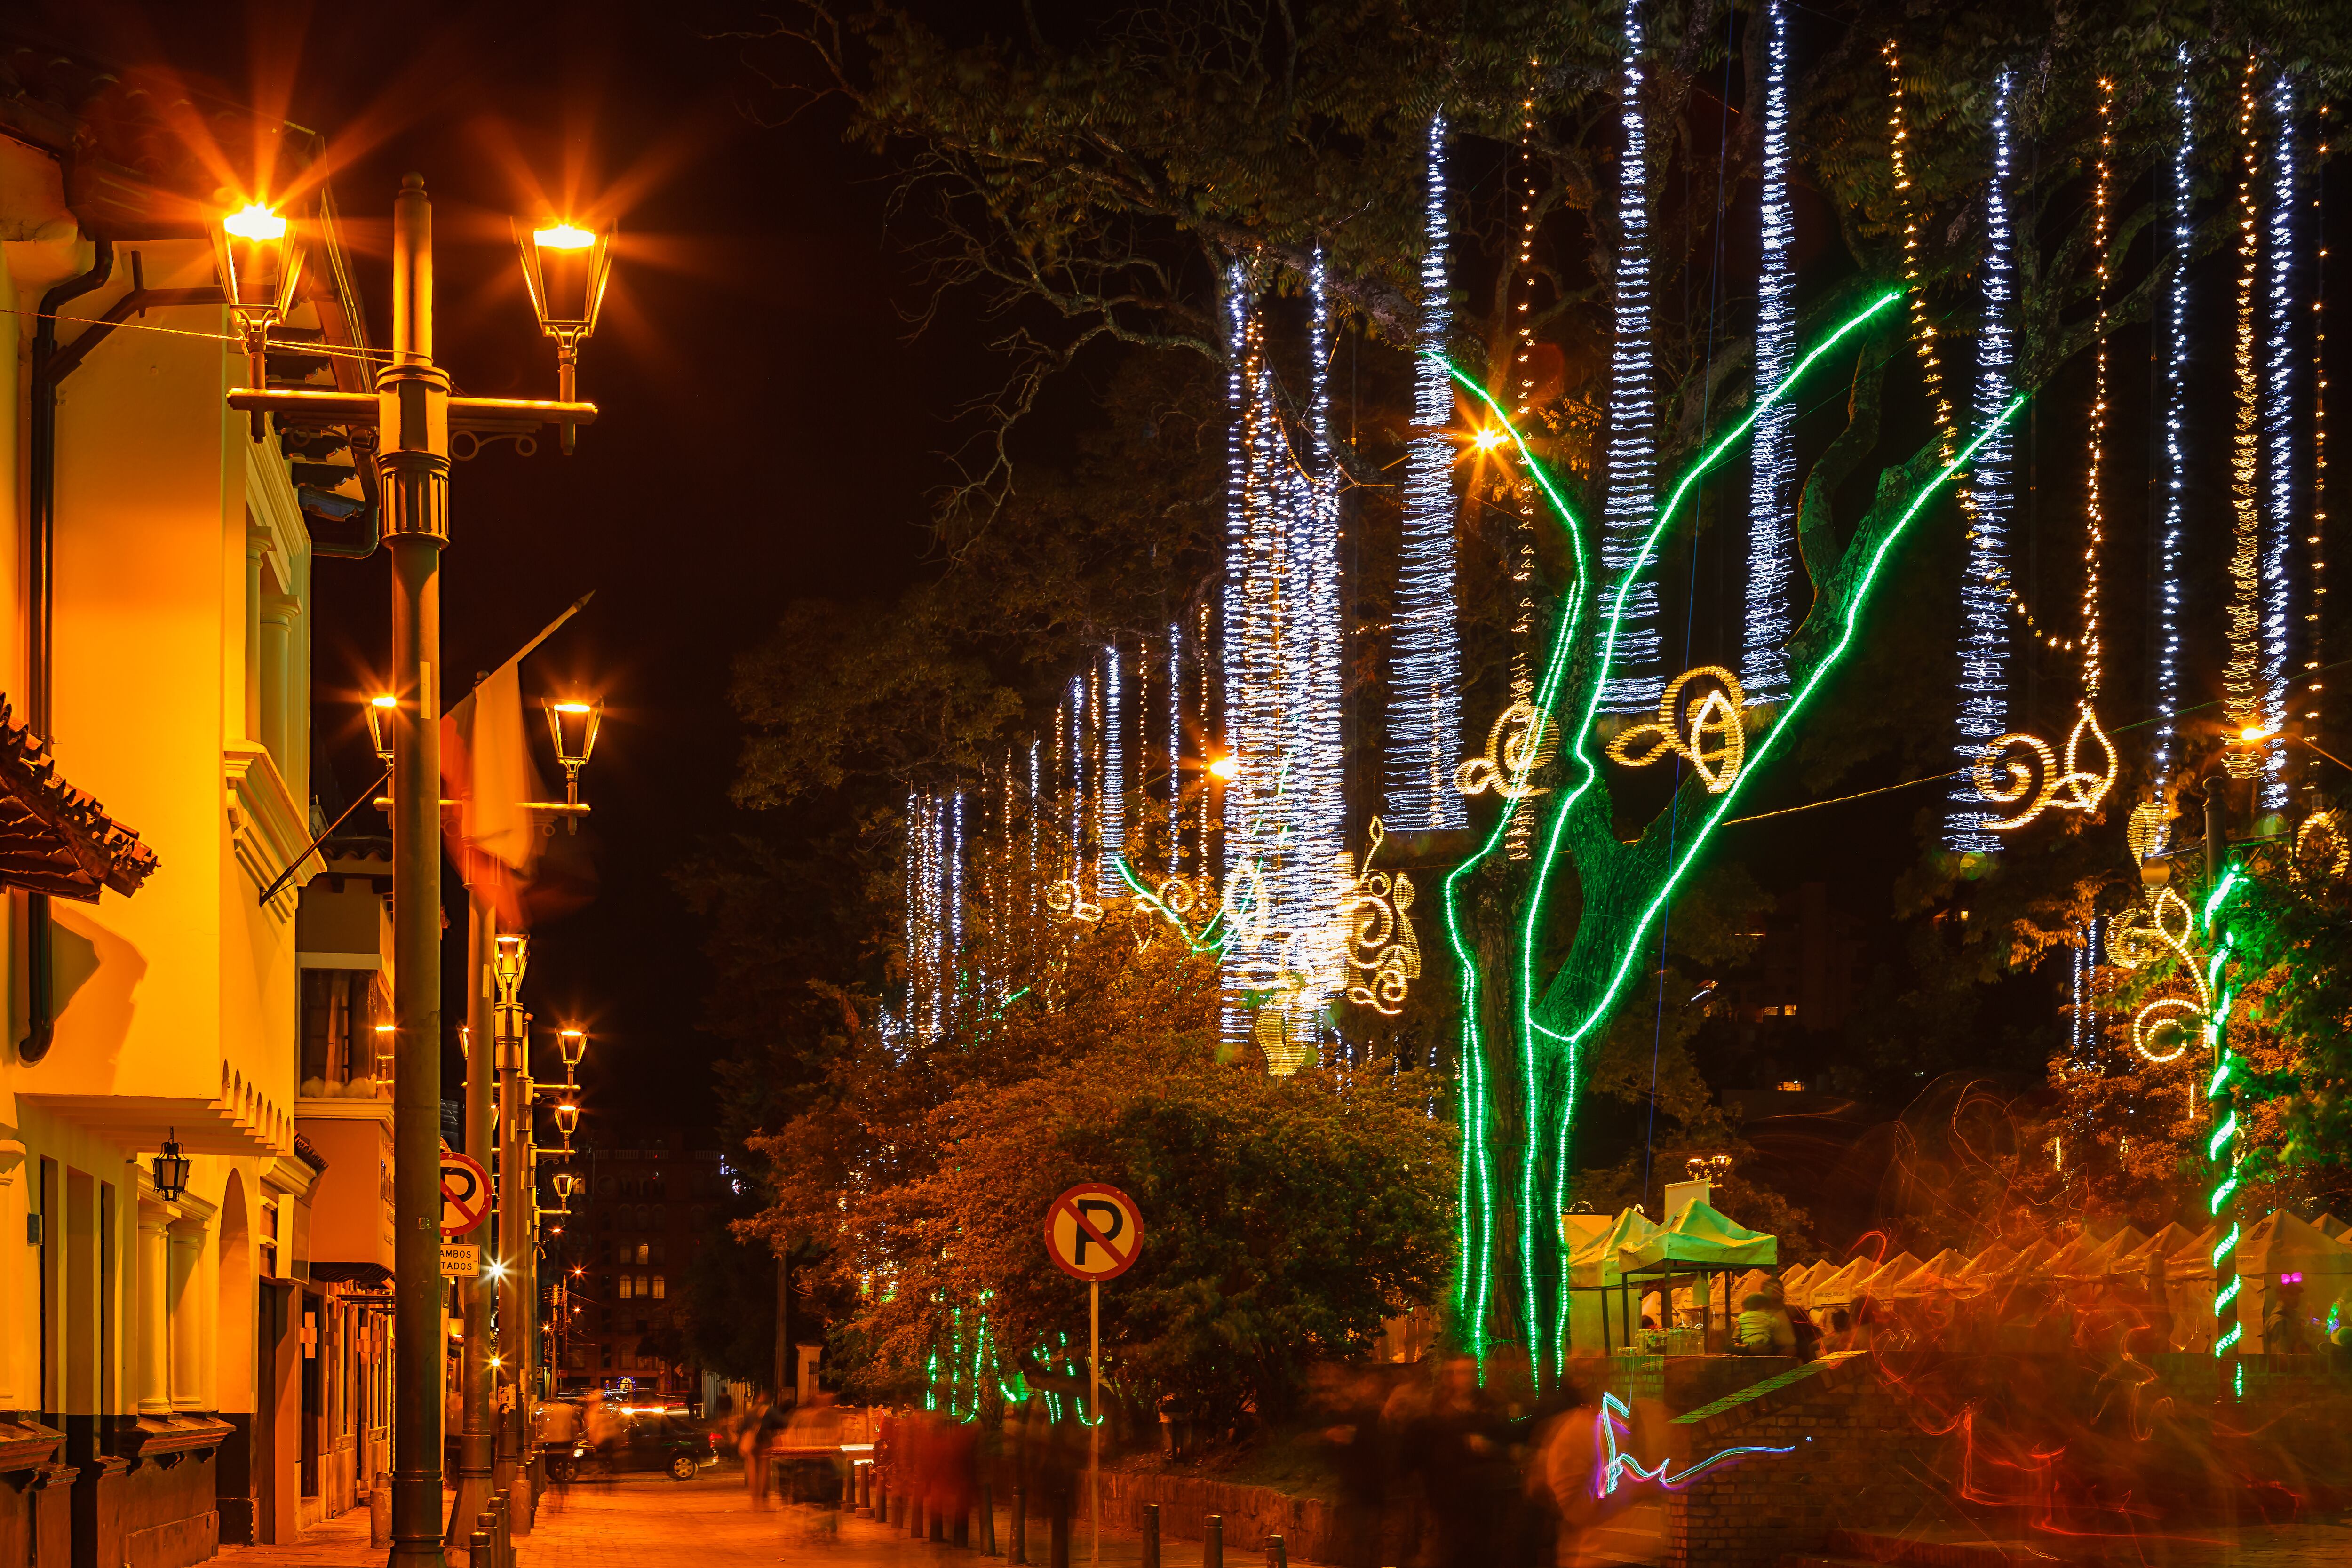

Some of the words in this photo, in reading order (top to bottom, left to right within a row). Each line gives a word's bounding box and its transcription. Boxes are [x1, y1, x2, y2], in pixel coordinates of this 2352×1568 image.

[1075, 1199, 1123, 1265] P
[440, 1250, 471, 1258] AMBOS
[441, 1262, 472, 1270] TADOS
